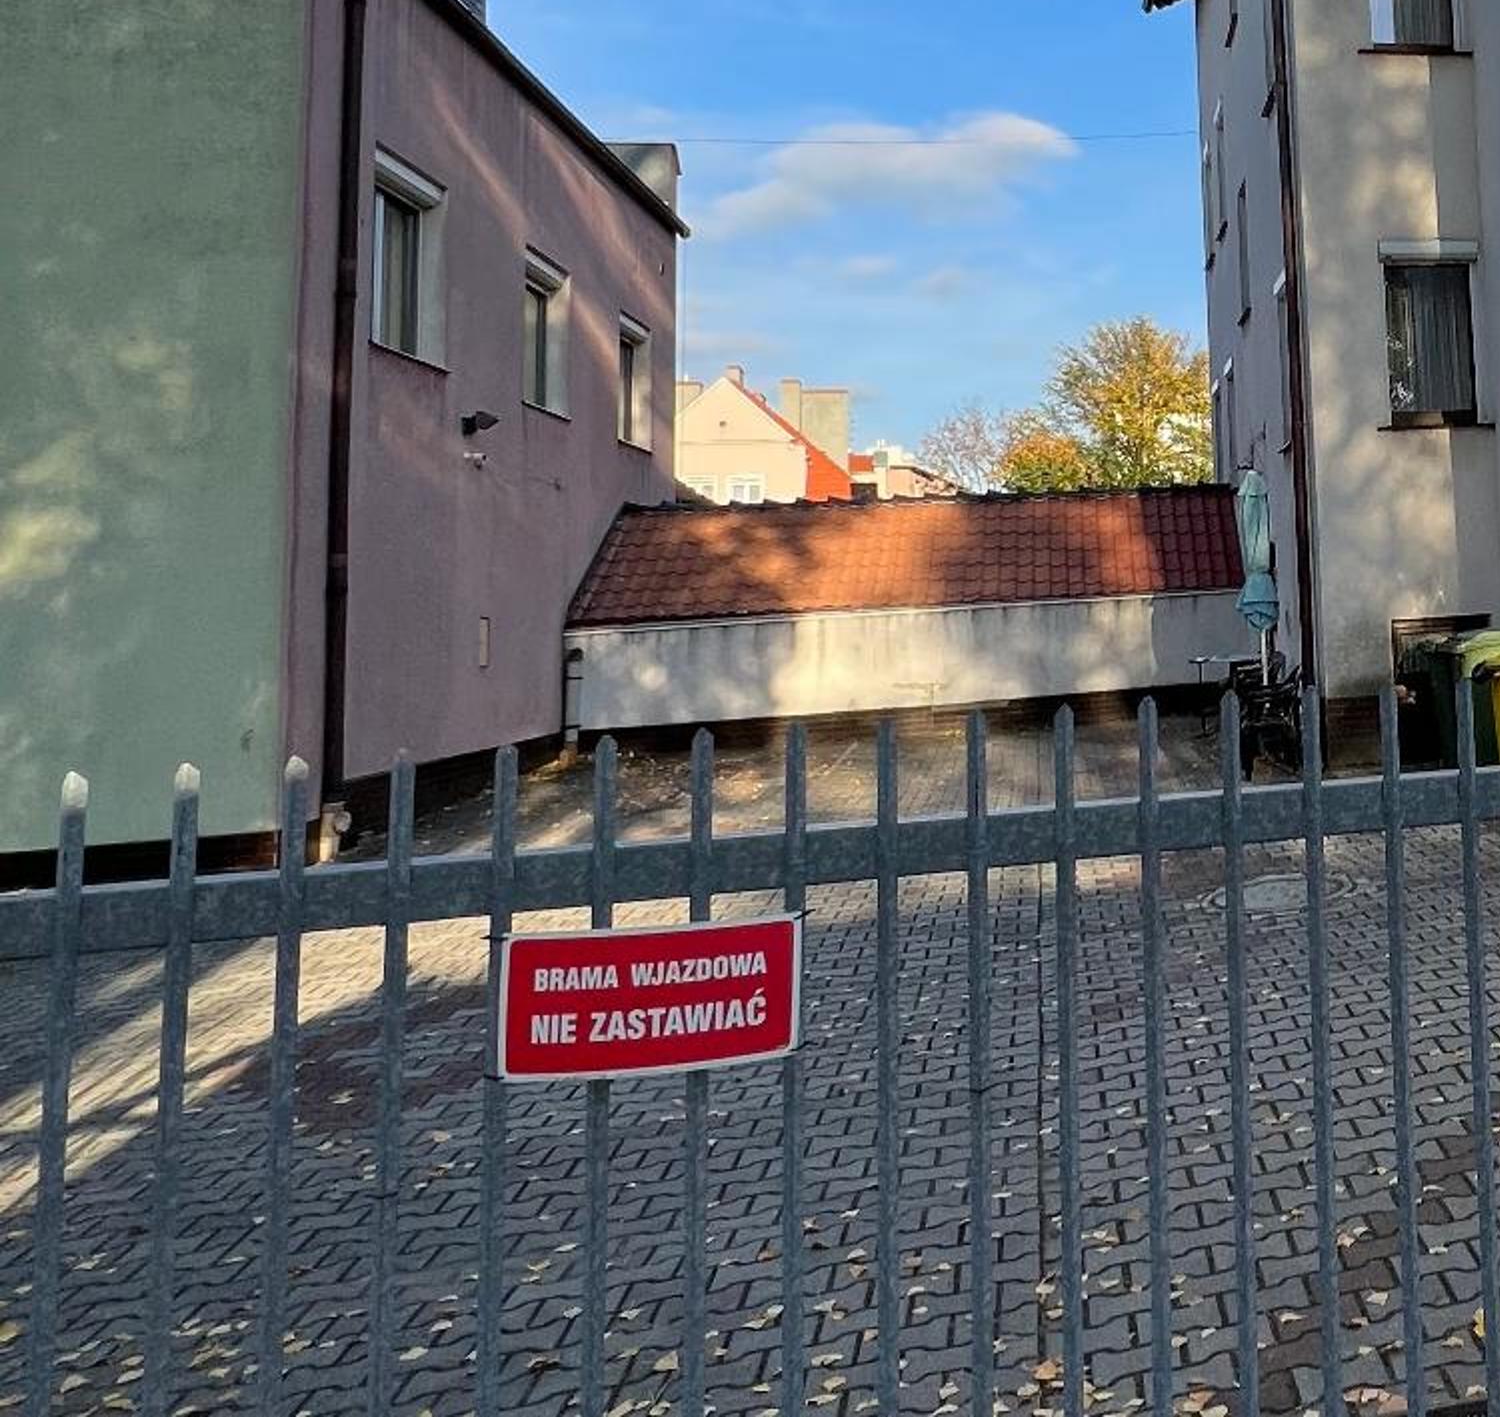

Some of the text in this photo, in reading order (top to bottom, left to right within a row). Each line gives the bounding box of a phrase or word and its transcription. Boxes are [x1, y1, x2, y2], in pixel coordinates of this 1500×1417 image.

[534, 951, 768, 992] BRAMA WJAZDOWA
[530, 987, 768, 1045] NIE ZASTAWIAĆ
